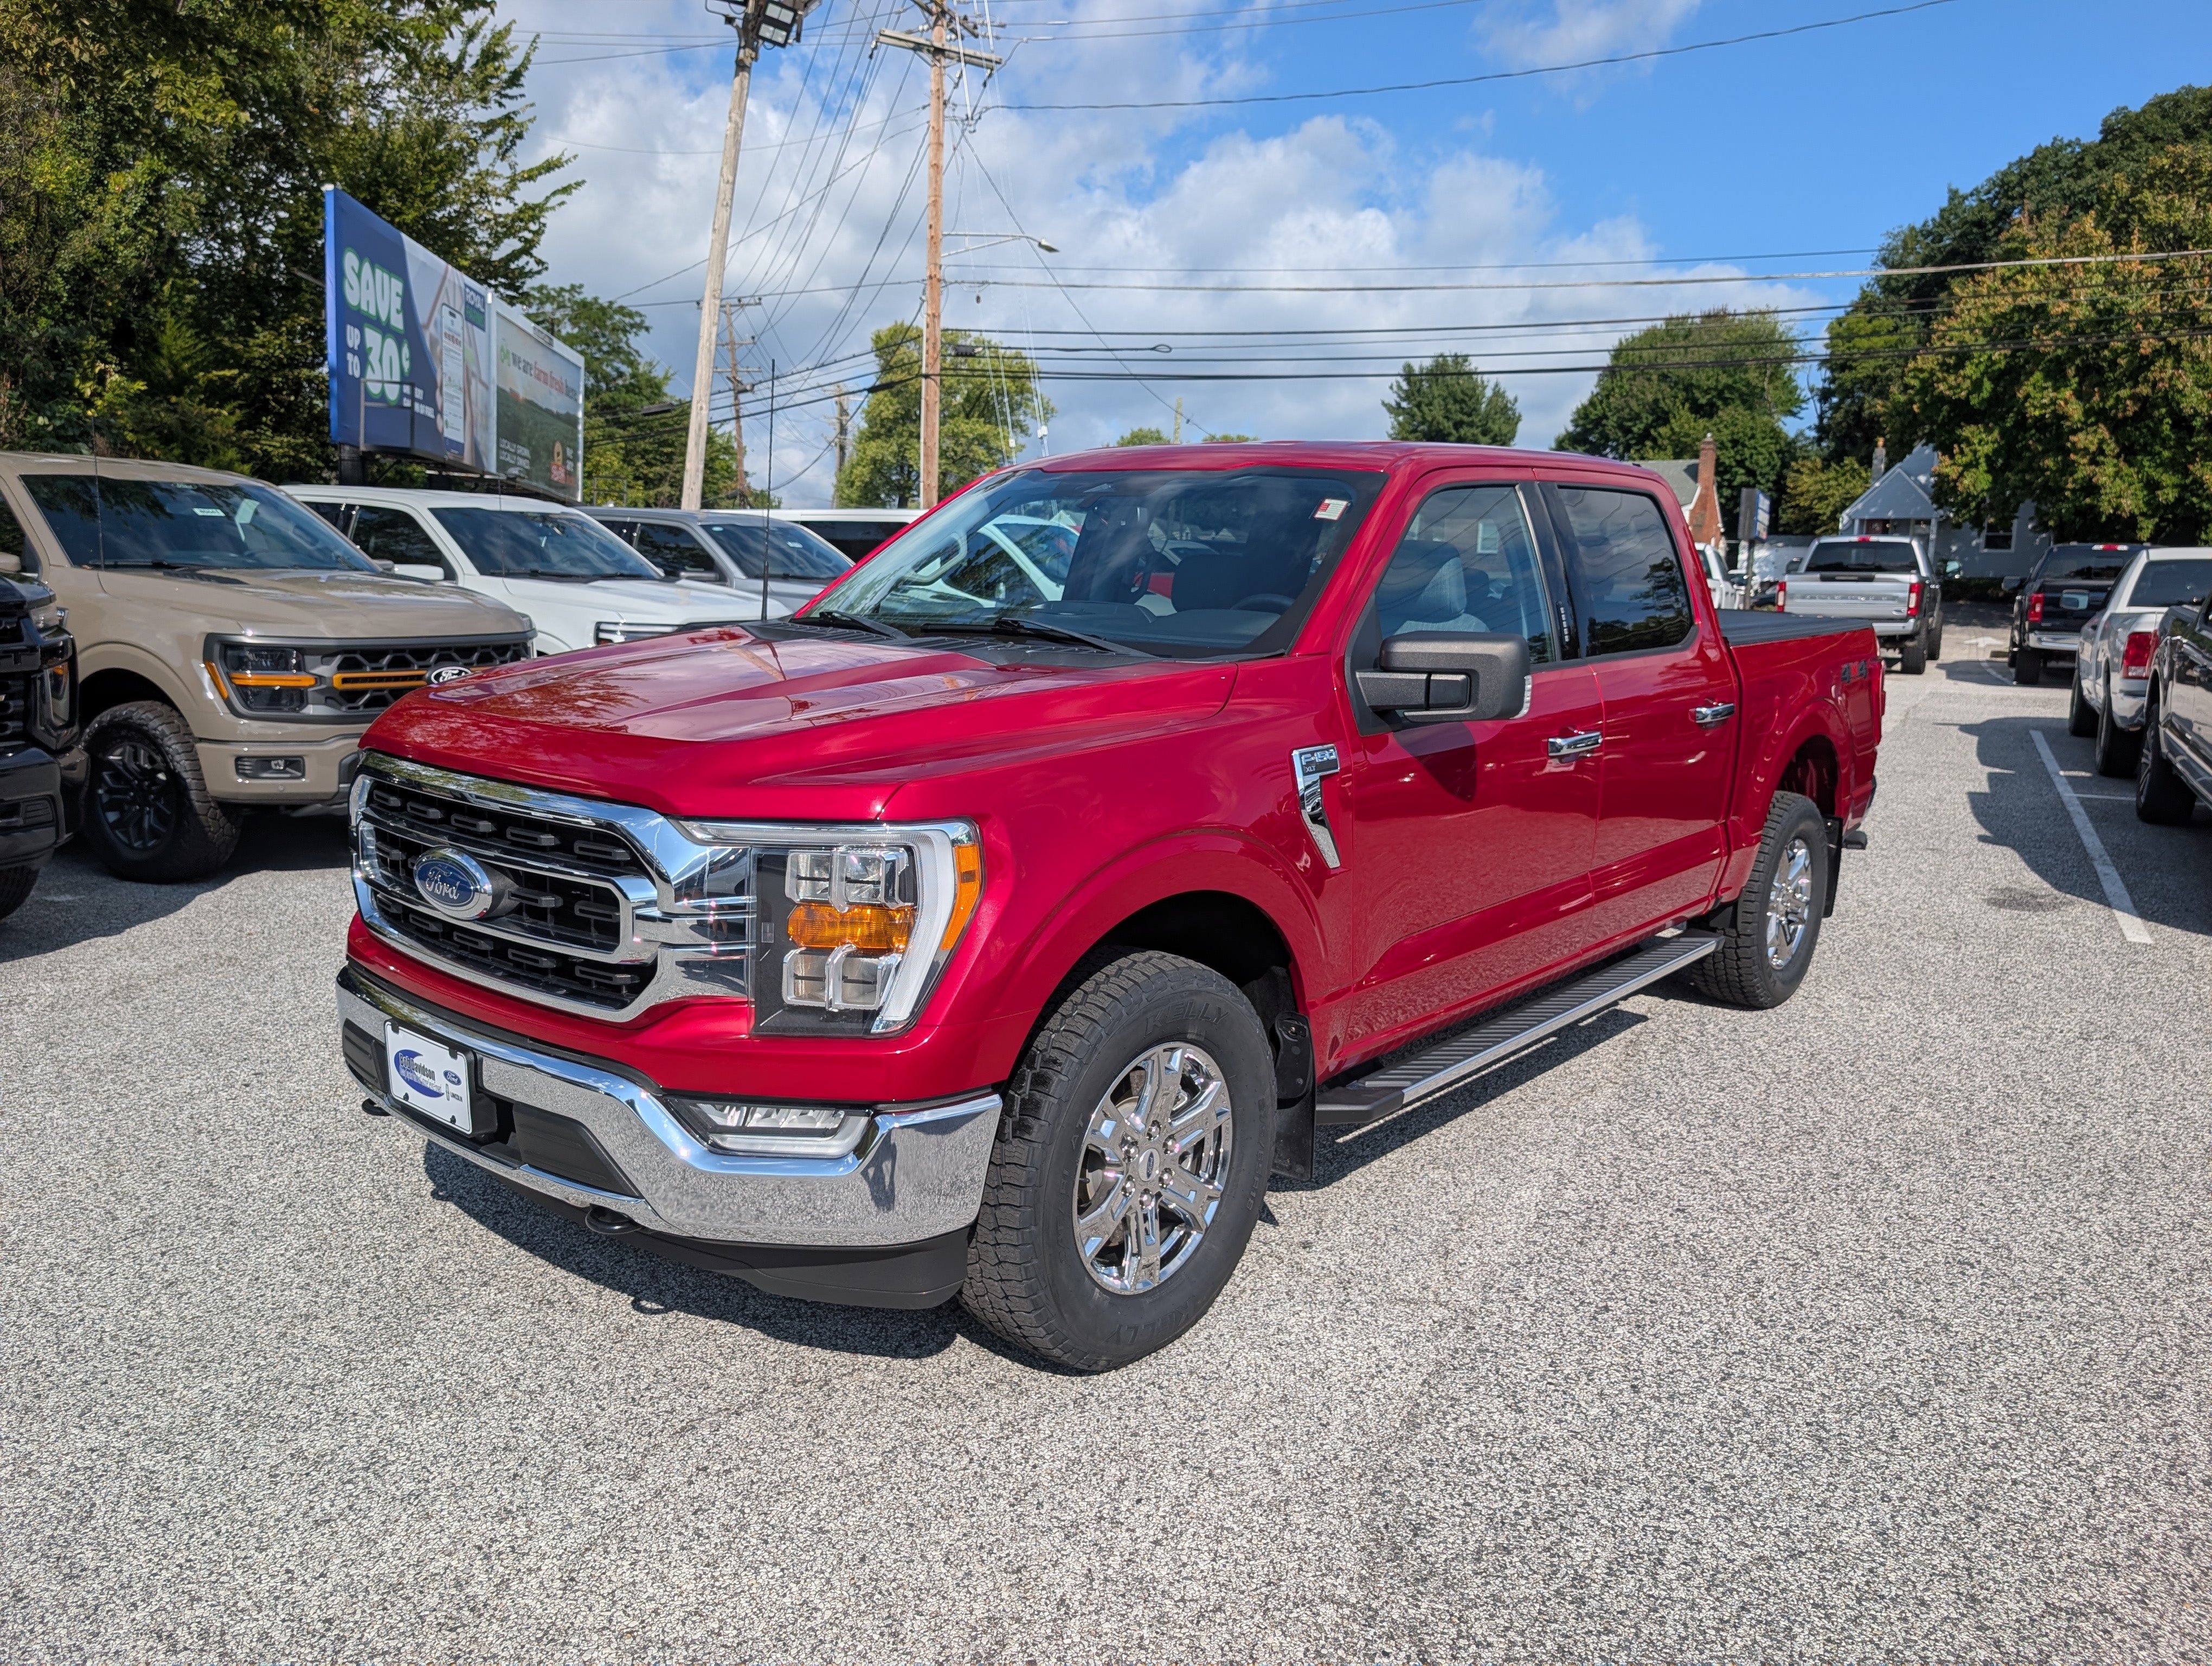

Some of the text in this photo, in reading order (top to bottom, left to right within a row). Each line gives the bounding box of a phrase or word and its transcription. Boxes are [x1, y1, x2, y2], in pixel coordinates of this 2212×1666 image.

[344, 249, 404, 332] SAVE
[466, 286, 485, 313] ROYAL
[346, 324, 361, 350] UP
[346, 351, 361, 379] TO
[1301, 749, 1336, 765] F-150
[426, 866, 460, 900] Ford
[1145, 1001, 1230, 1036] KELLY
[399, 1053, 410, 1069] Bob
[410, 1057, 435, 1081] Davidson
[446, 1072, 459, 1084] Ford
